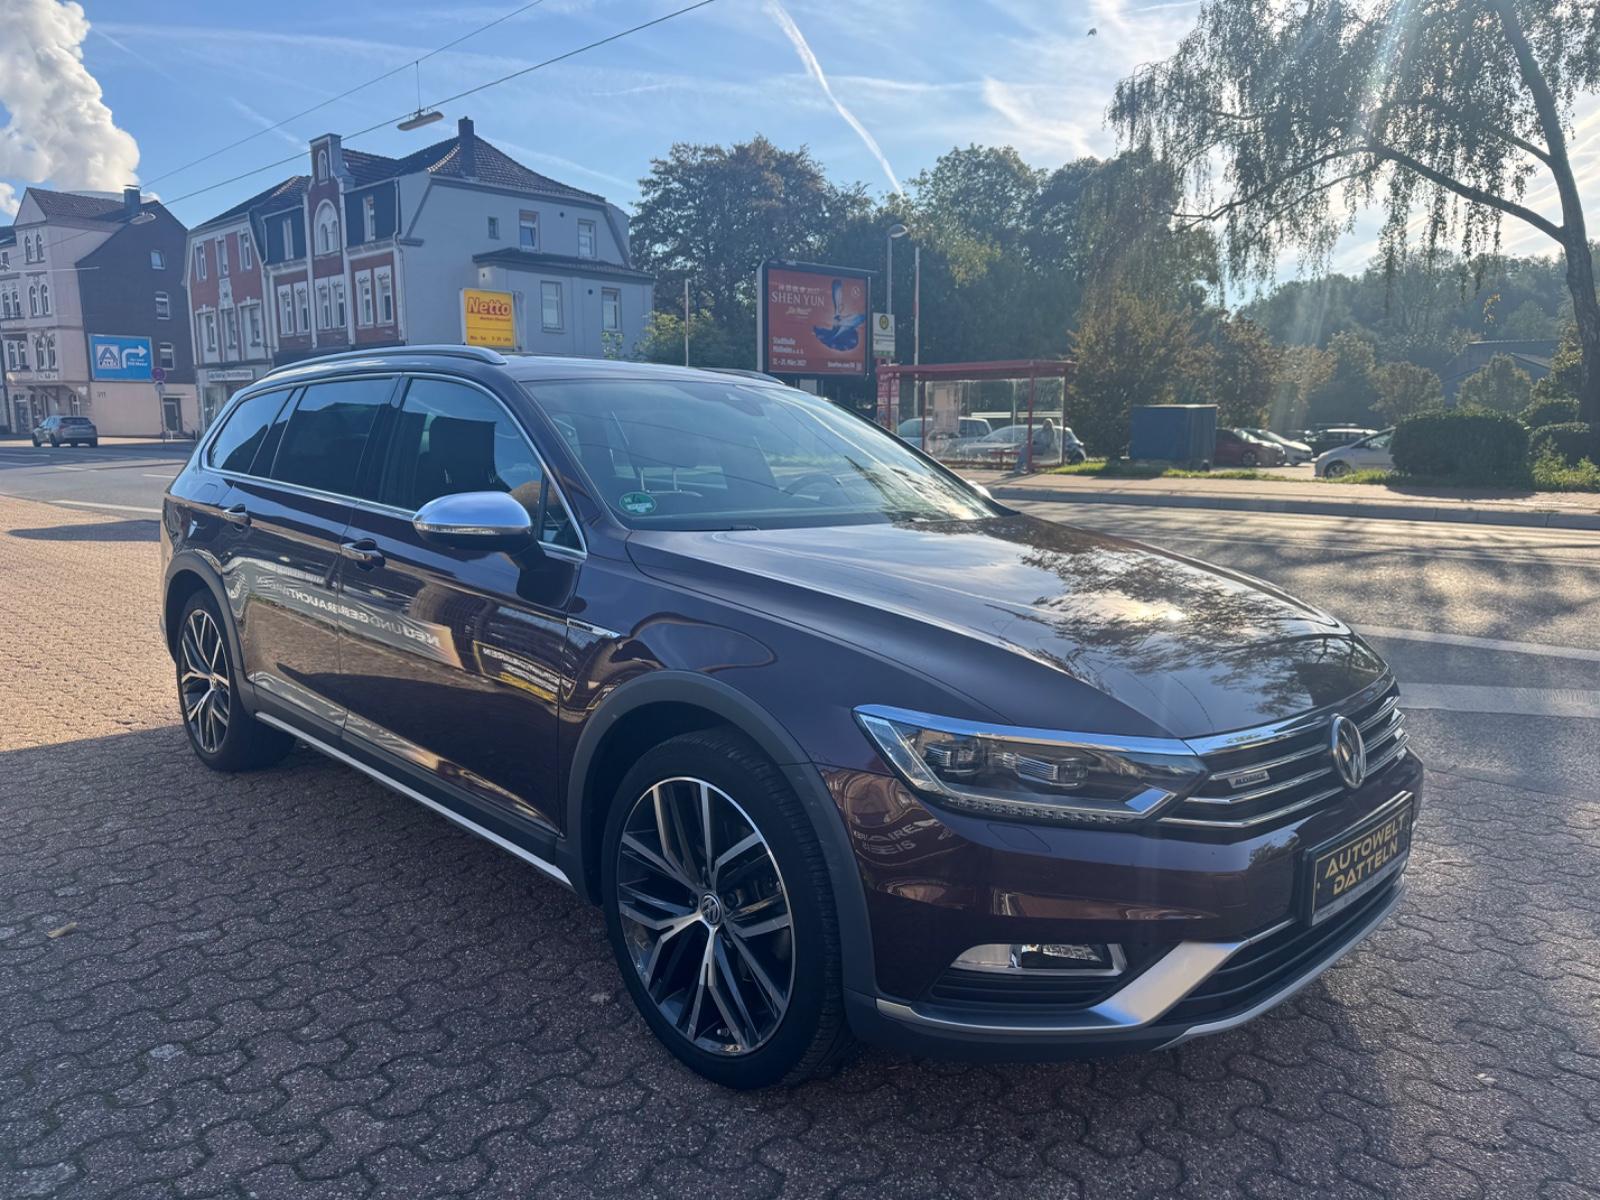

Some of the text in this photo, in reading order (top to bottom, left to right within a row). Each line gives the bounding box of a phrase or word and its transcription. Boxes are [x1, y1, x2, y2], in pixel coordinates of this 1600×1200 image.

[466, 296, 512, 316] Netto
[771, 291, 825, 307] SHEN YUN
[1325, 814, 1405, 879] AUTOWELT
[1333, 837, 1398, 895] DATTELN
